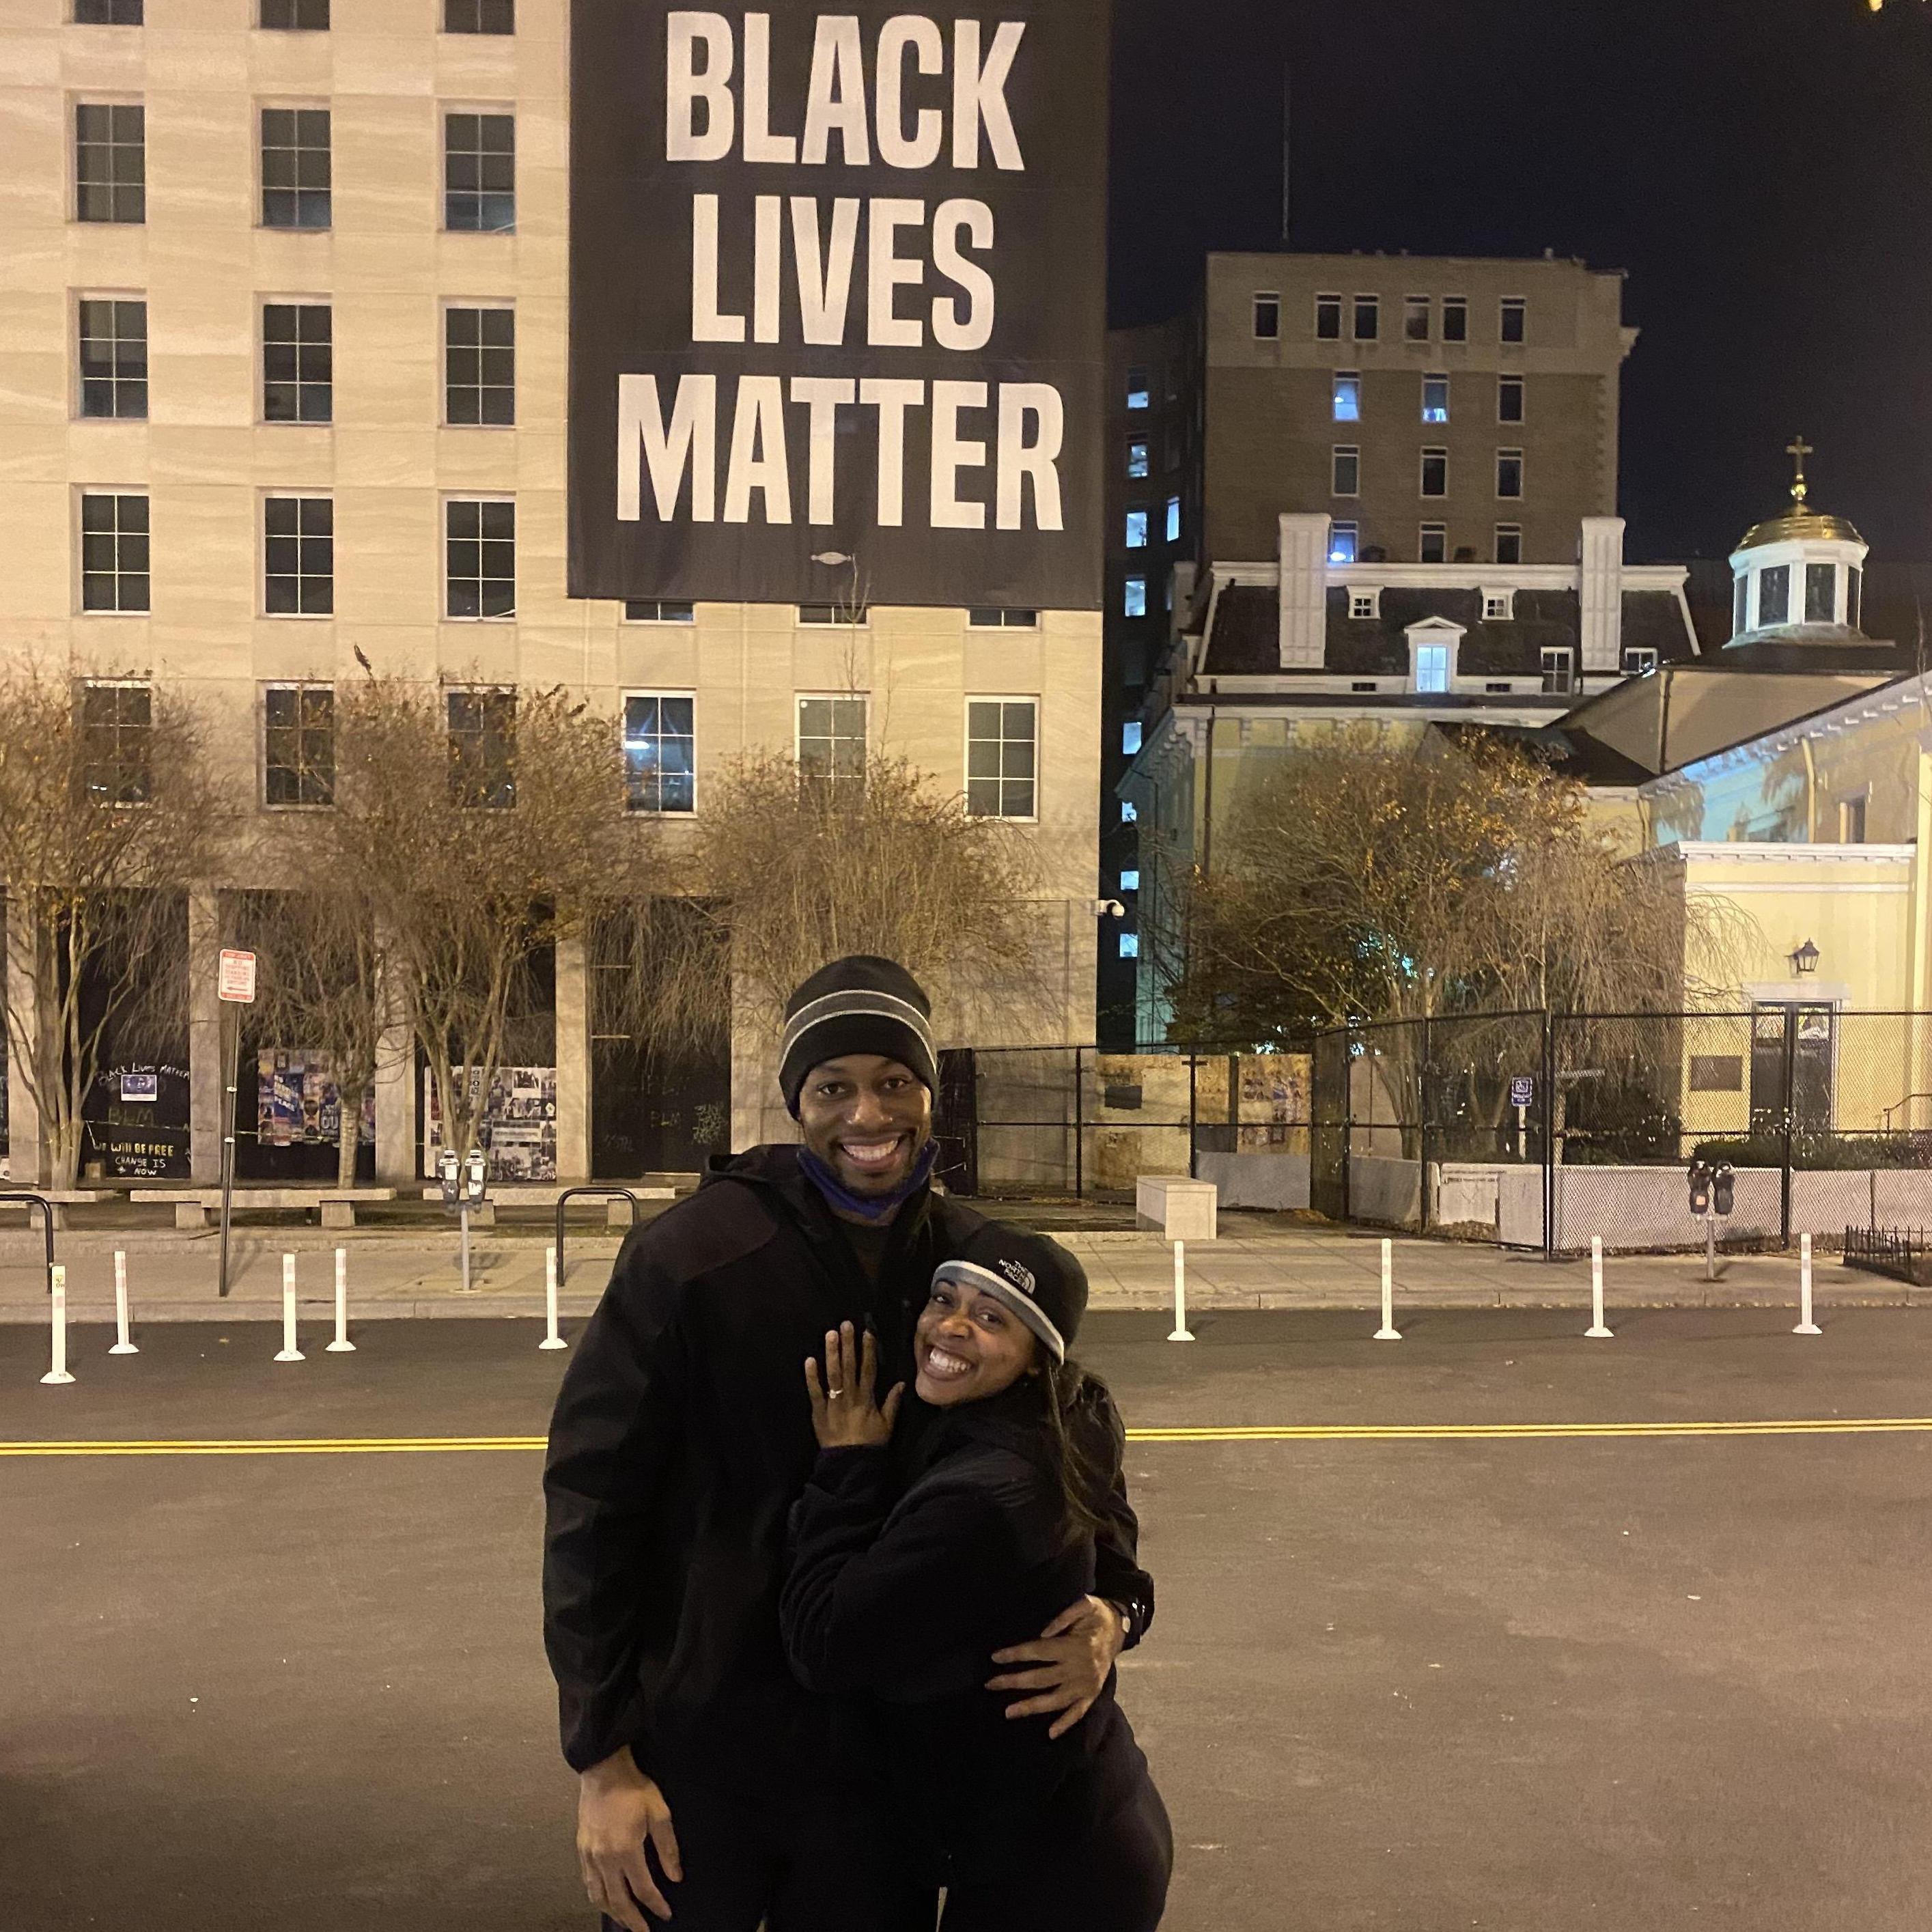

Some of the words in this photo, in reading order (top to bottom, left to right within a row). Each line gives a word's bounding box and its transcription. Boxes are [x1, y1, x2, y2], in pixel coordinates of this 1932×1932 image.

[666, 11, 1026, 171] BLACK
[692, 194, 995, 350] LIVES
[617, 374, 1064, 531] MATTER
[152, 1159, 166, 1168] IS
